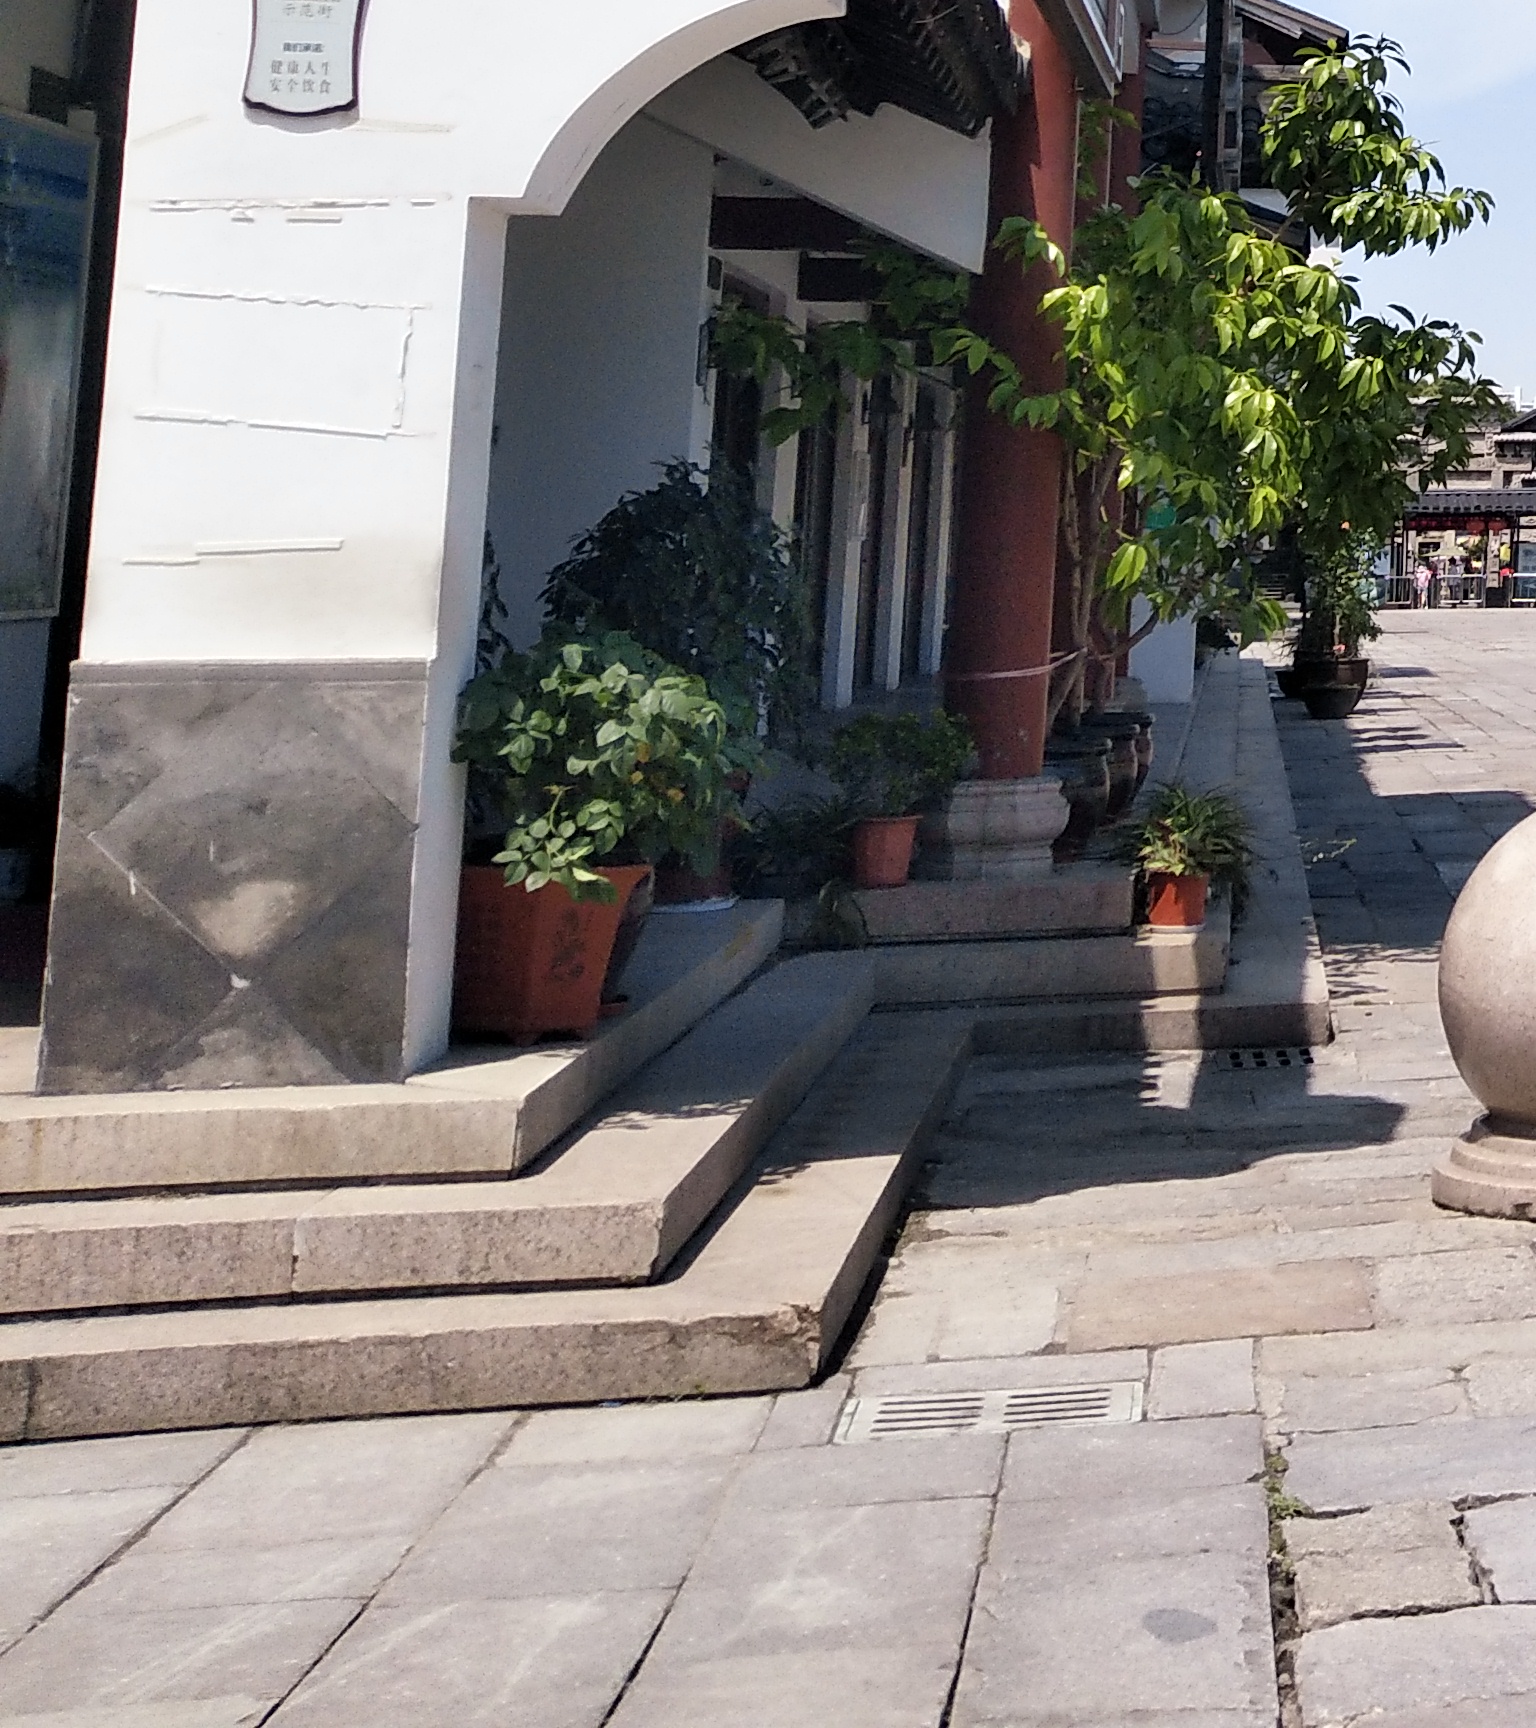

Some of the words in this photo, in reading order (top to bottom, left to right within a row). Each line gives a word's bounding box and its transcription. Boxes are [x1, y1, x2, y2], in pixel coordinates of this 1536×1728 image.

[271, 60, 329, 76] 健康人生
[270, 79, 331, 94] 安全饮食
